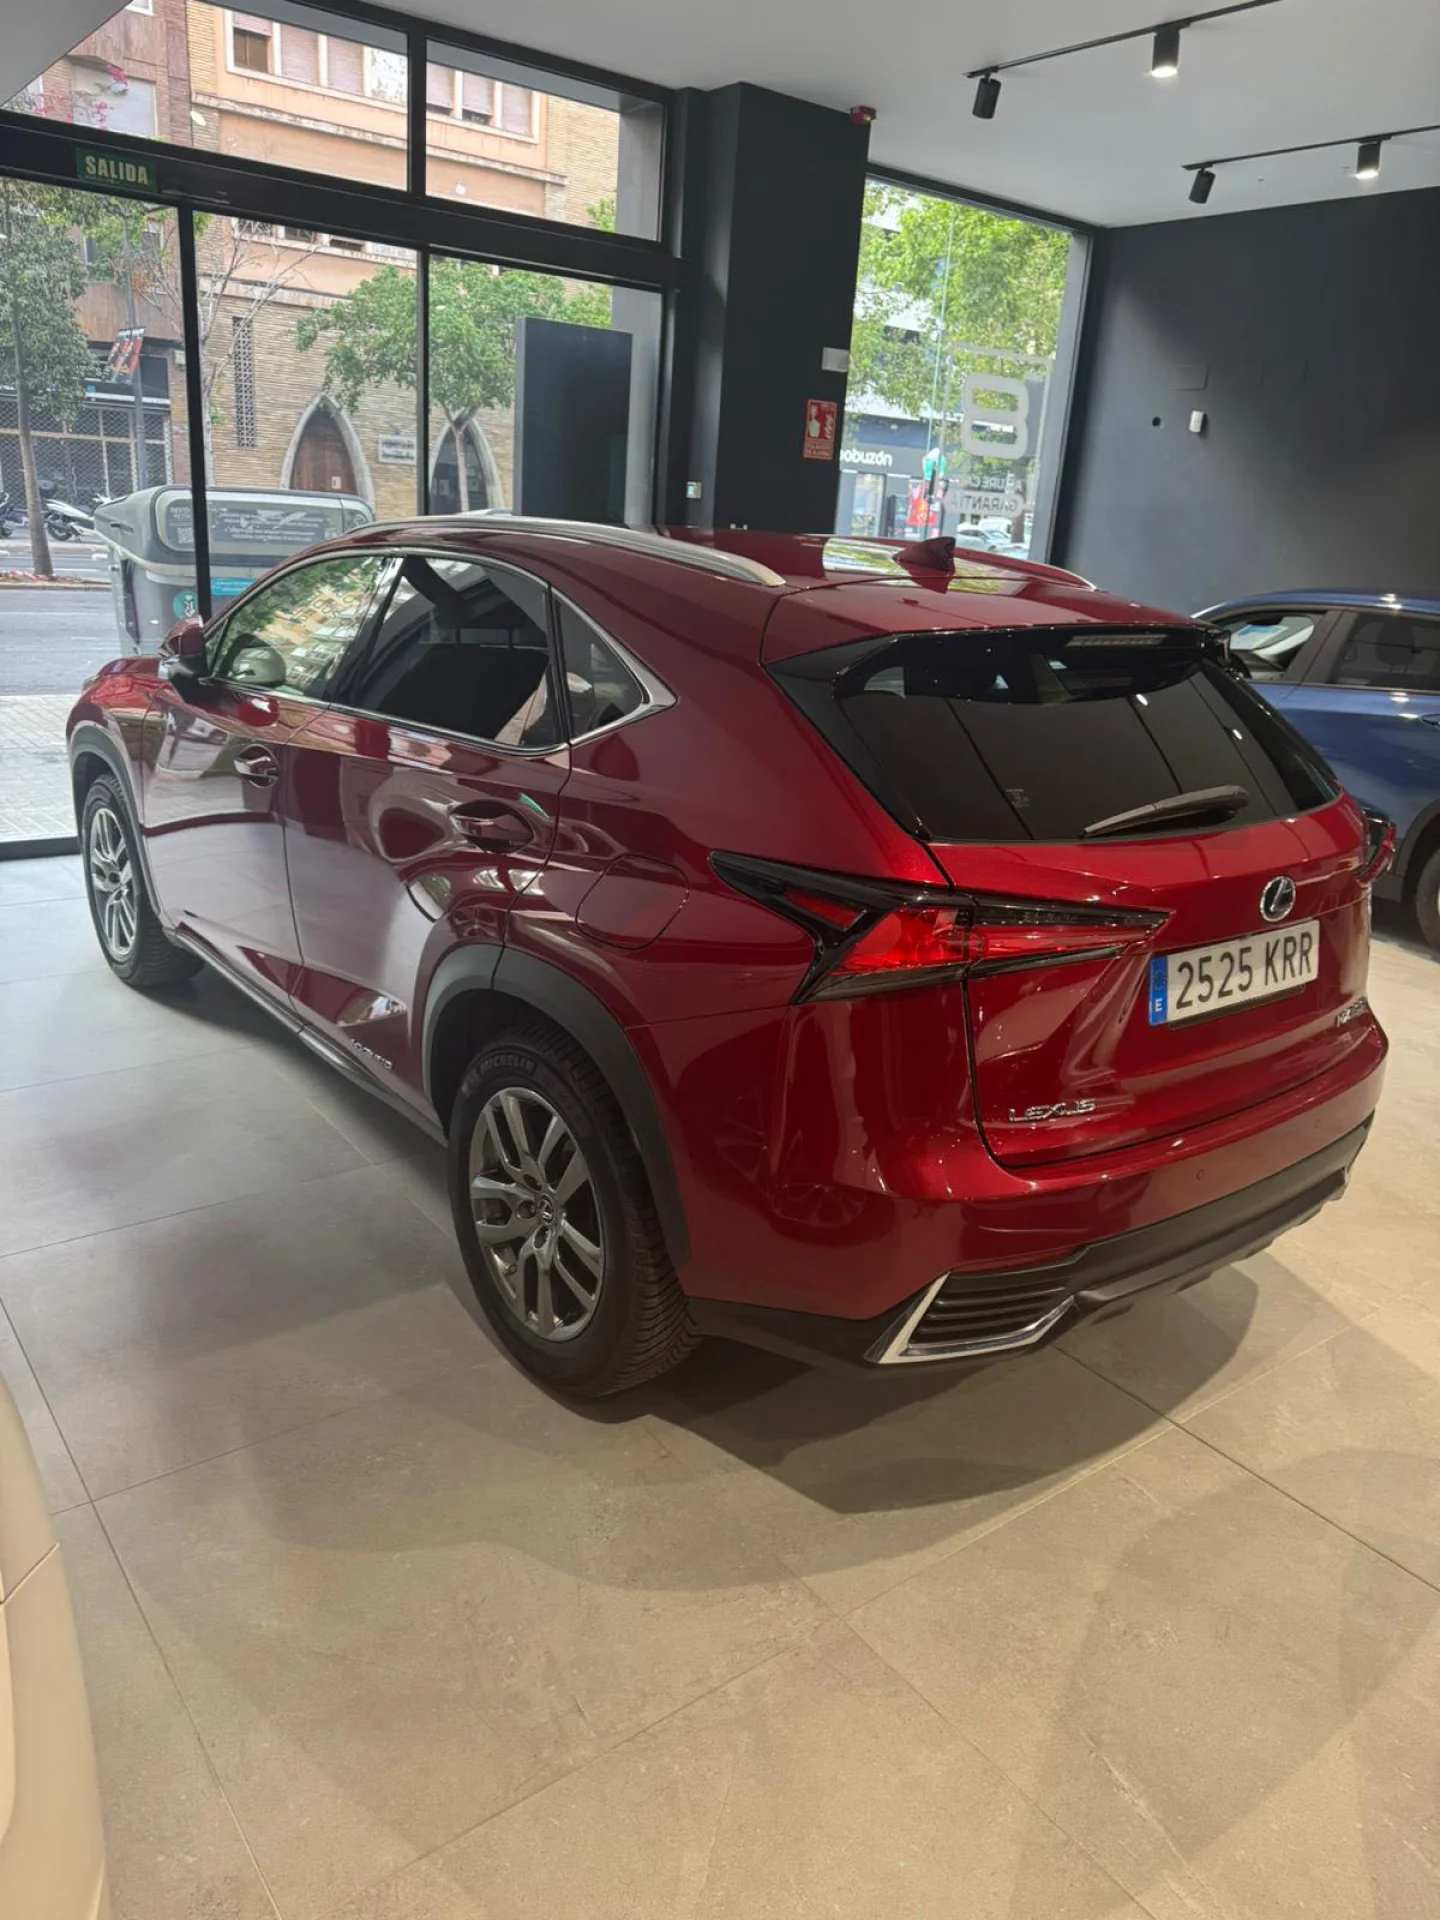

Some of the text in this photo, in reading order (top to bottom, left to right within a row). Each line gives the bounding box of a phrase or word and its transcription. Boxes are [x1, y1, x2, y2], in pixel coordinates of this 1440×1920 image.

[84, 155, 149, 185] SALIDA
[1155, 931, 1313, 1012] E 2525 KRR
[479, 1053, 536, 1076] MICHELIN
[1008, 1098, 1096, 1122] LEXUS
